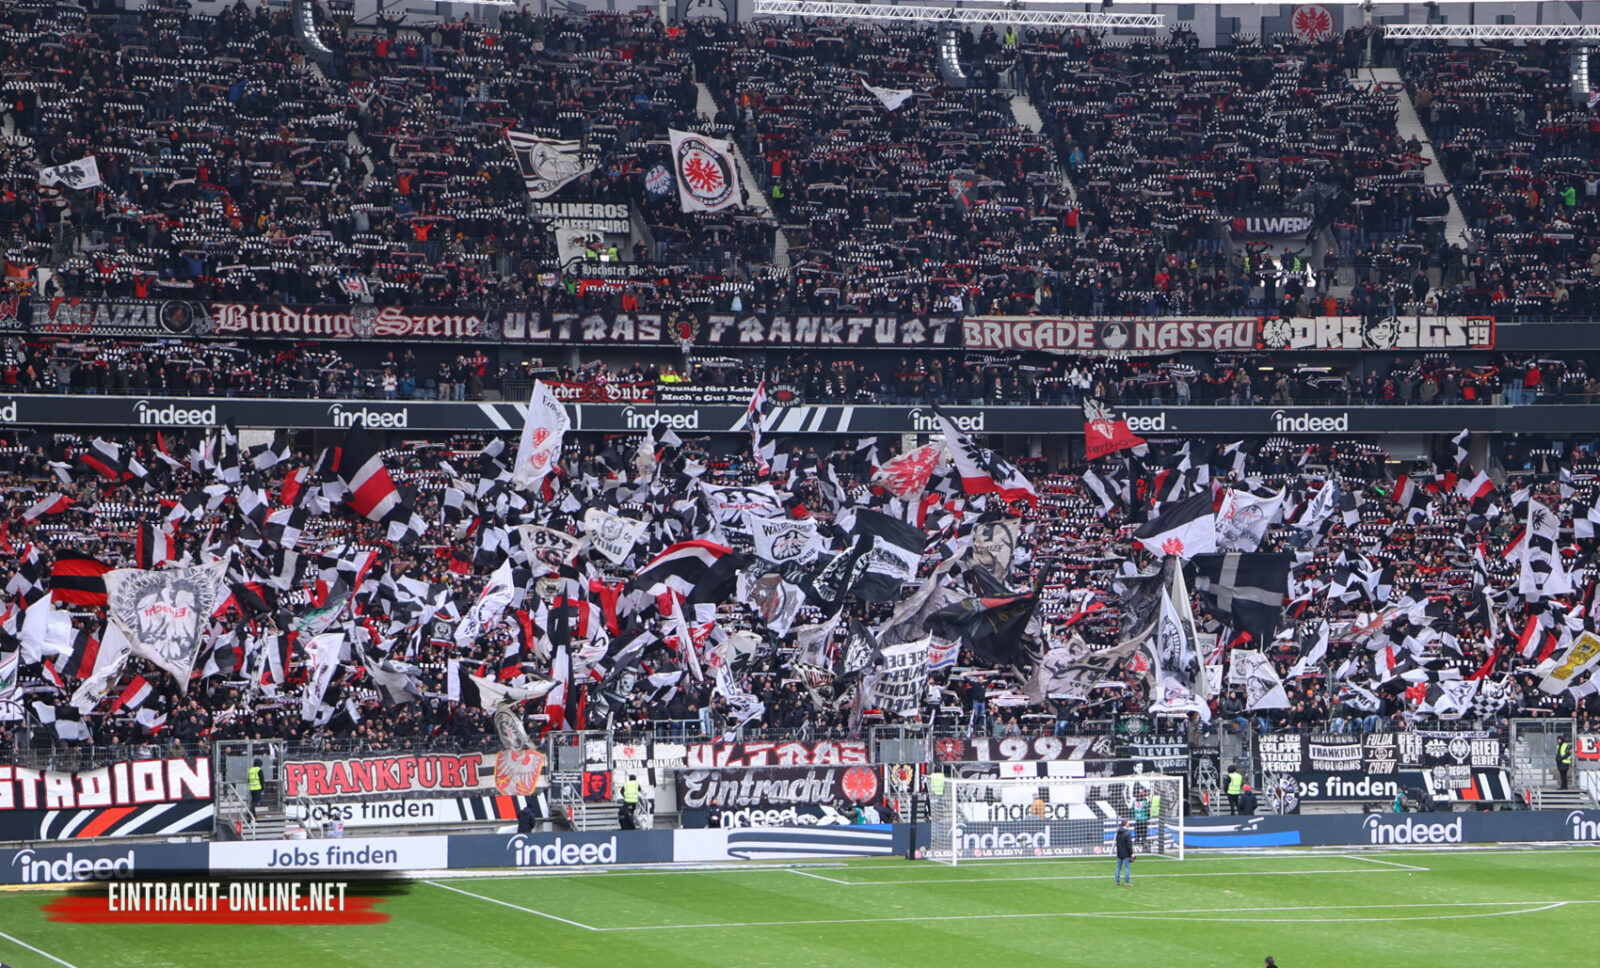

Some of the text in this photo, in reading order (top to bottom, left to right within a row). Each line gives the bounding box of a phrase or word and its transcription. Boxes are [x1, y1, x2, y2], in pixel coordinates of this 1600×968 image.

[532, 202, 629, 218] CALIMEROS
[542, 219, 630, 233] CHAFFENBURG
[31, 303, 157, 327] RAGAZZI
[213, 303, 481, 338] Binding Szene
[502, 312, 955, 344] ULTRAS FRANKFURT
[963, 321, 1254, 350] BRIGADE NASSAU
[1468, 326, 1490, 345] 99
[544, 383, 583, 400] ieder
[656, 385, 704, 393] Freunde
[706, 385, 727, 393] fürs
[704, 394, 725, 402] Gut
[727, 394, 753, 402] Pete
[135, 402, 216, 426] indeed
[330, 404, 408, 428] indeed
[625, 408, 699, 430] indeed
[909, 409, 985, 431] inded
[1273, 410, 1349, 433] indeed
[971, 736, 1096, 762] 1997
[1133, 736, 1184, 745] ULTRAS
[1259, 743, 1301, 752] GRUPPE
[1366, 733, 1393, 746] FULDA
[1471, 740, 1499, 756] RIED
[688, 741, 870, 768] ULTRAS
[1138, 747, 1181, 756] NEVER
[1260, 753, 1302, 762] STADION
[1312, 747, 1362, 758] FRANKFURT
[1403, 753, 1419, 764] 64
[1471, 755, 1499, 766] GEBIET
[616, 759, 643, 769] NUOVA
[1261, 761, 1301, 772] VERBOT
[1313, 760, 1361, 771] HOOLIGANS
[1368, 760, 1395, 774] CREW
[283, 753, 483, 797] FRANKFURT
[1433, 779, 1447, 789] 61
[683, 769, 836, 809] Eintracht
[1325, 776, 1398, 797] finden
[362, 800, 434, 818] finden
[720, 806, 797, 828] ndeed
[950, 824, 1051, 849] indeed
[1365, 814, 1463, 844] indeed
[268, 845, 398, 867] Jobs finden
[509, 834, 618, 866] indeed
[15, 849, 135, 882] indeed
